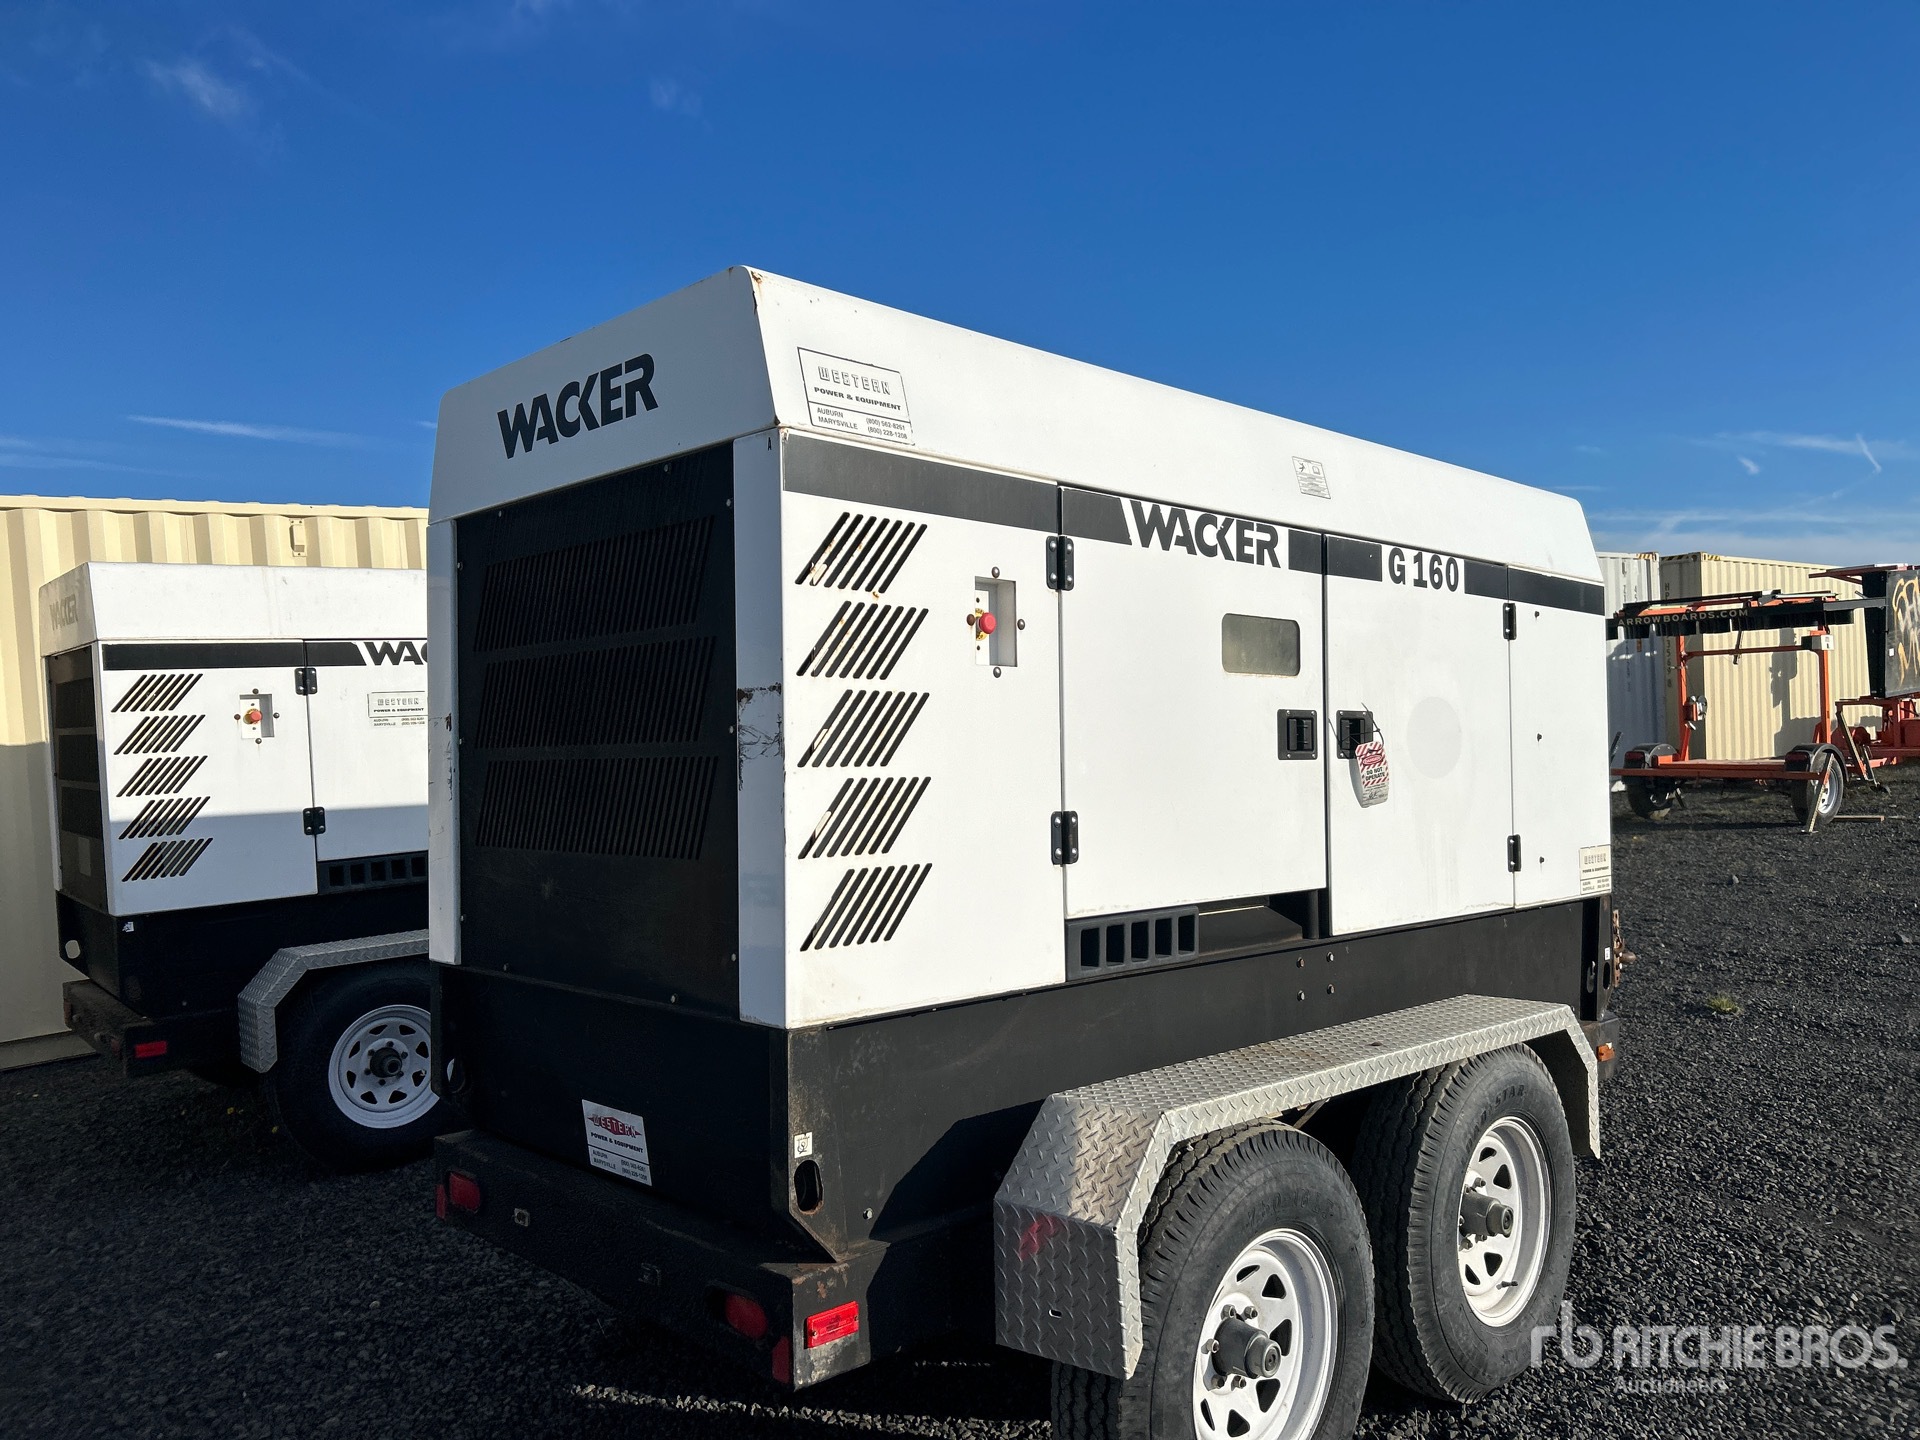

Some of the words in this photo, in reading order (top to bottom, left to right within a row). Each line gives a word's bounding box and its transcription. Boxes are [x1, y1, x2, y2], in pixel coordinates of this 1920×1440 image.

[818, 366, 890, 395] WESTERN
[497, 353, 658, 460] WACKER
[814, 386, 844, 399] POWER
[855, 395, 901, 411] EQUIPMENT
[817, 407, 844, 418] AUBURN
[818, 416, 858, 430] MARYSVILLE
[1129, 499, 1281, 569] WACKER
[49, 594, 79, 631] WACKER
[1618, 609, 1748, 626] ARROWBOARDS.COM
[592, 1113, 637, 1139] WESTERN
[590, 1132, 608, 1143] POWER
[614, 1139, 644, 1154] EQUIPMENT
